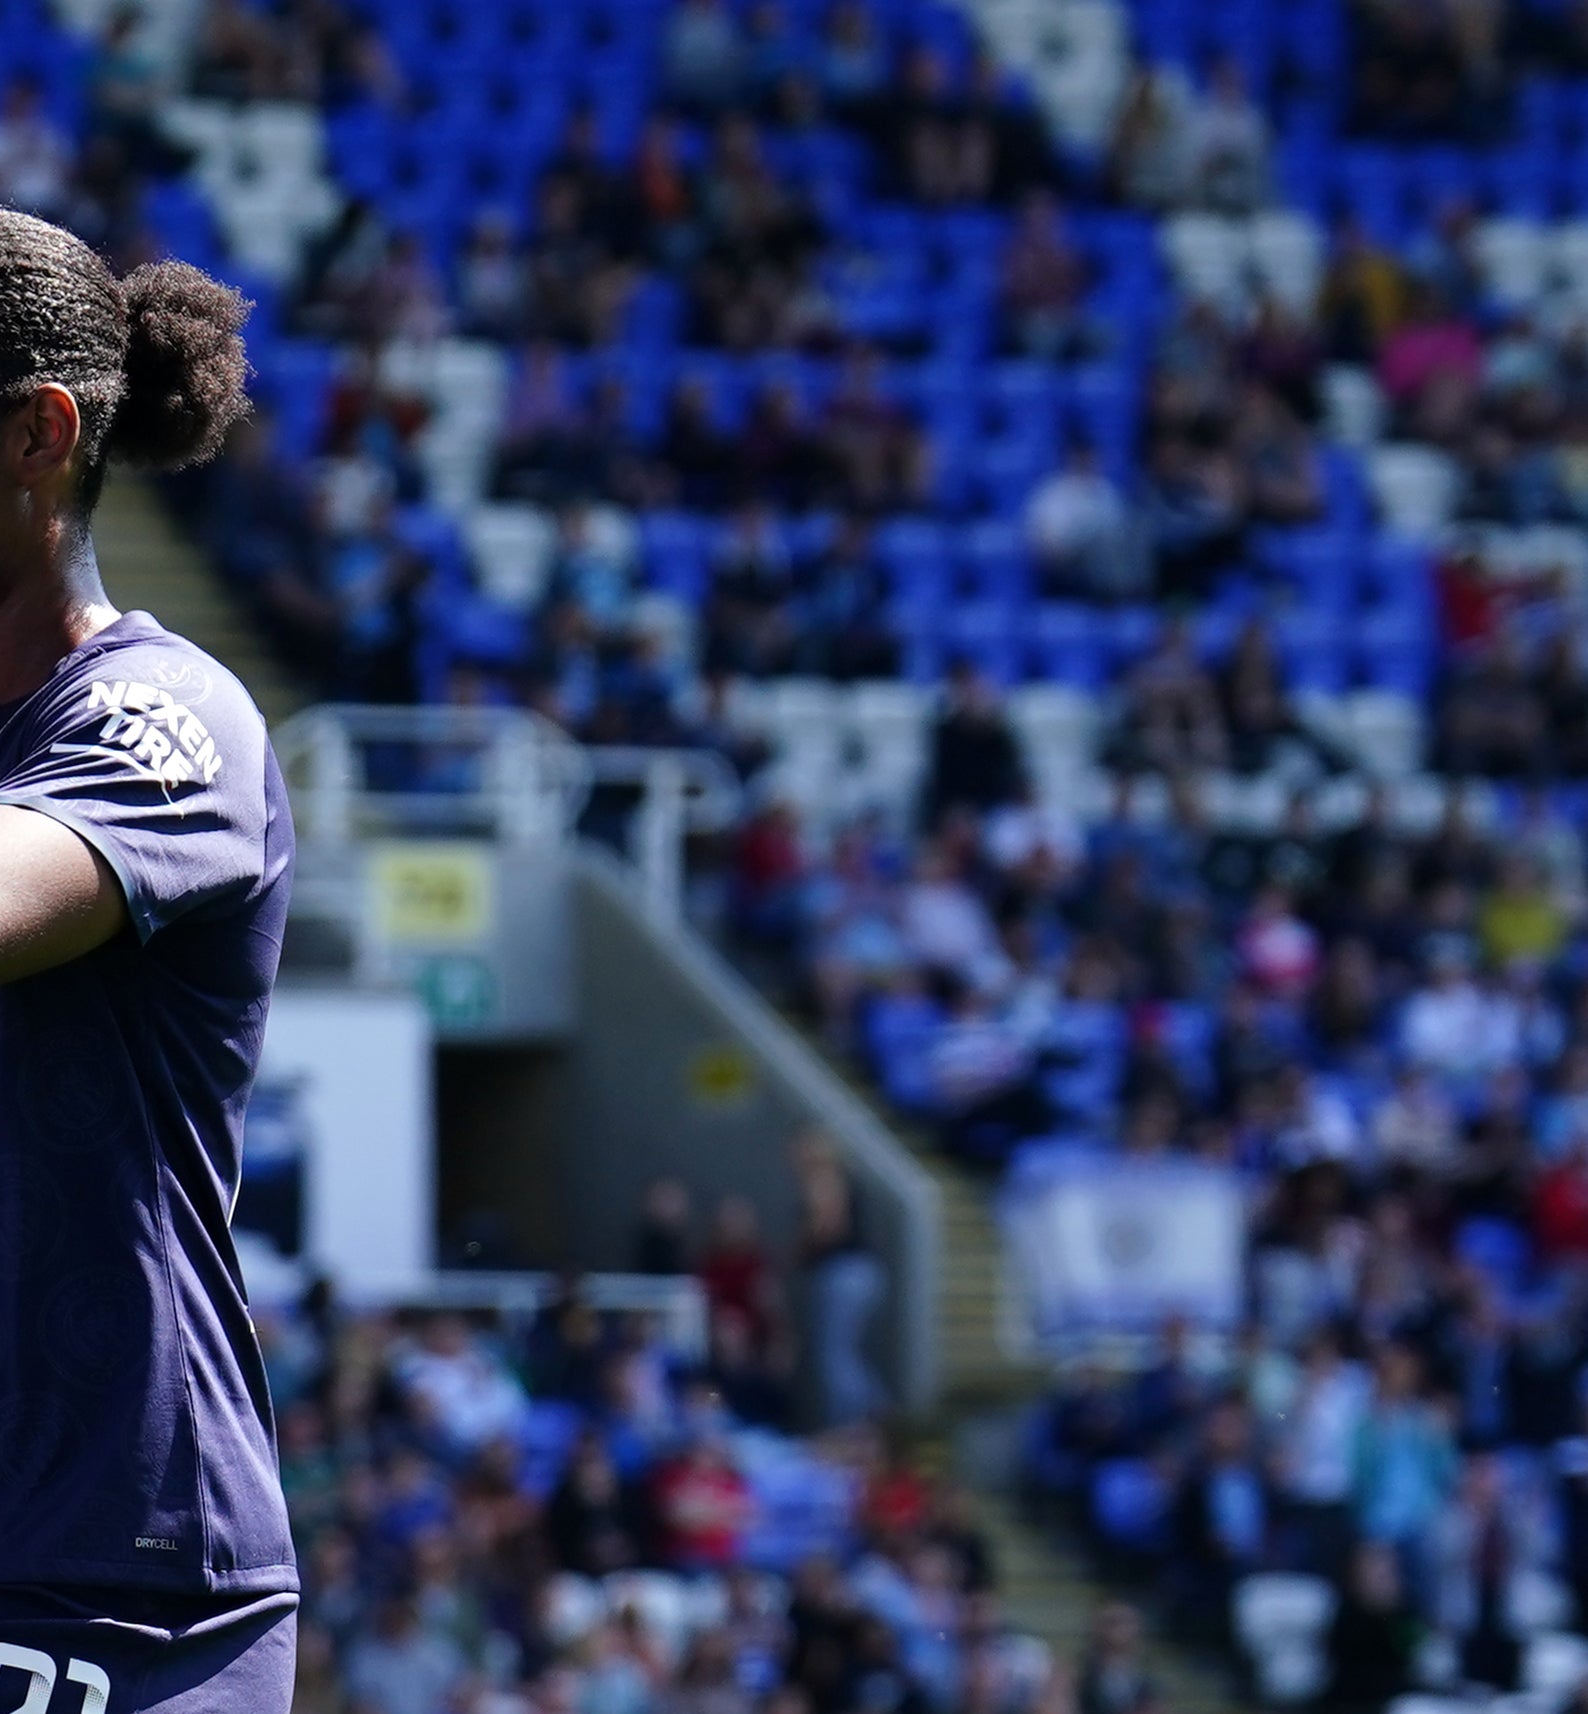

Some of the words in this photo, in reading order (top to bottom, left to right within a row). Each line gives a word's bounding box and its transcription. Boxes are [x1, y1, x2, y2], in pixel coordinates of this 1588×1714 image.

[87, 680, 223, 784] NEXEN
[99, 706, 195, 790] TIRE
[134, 1536, 179, 1551] DRYCELL
